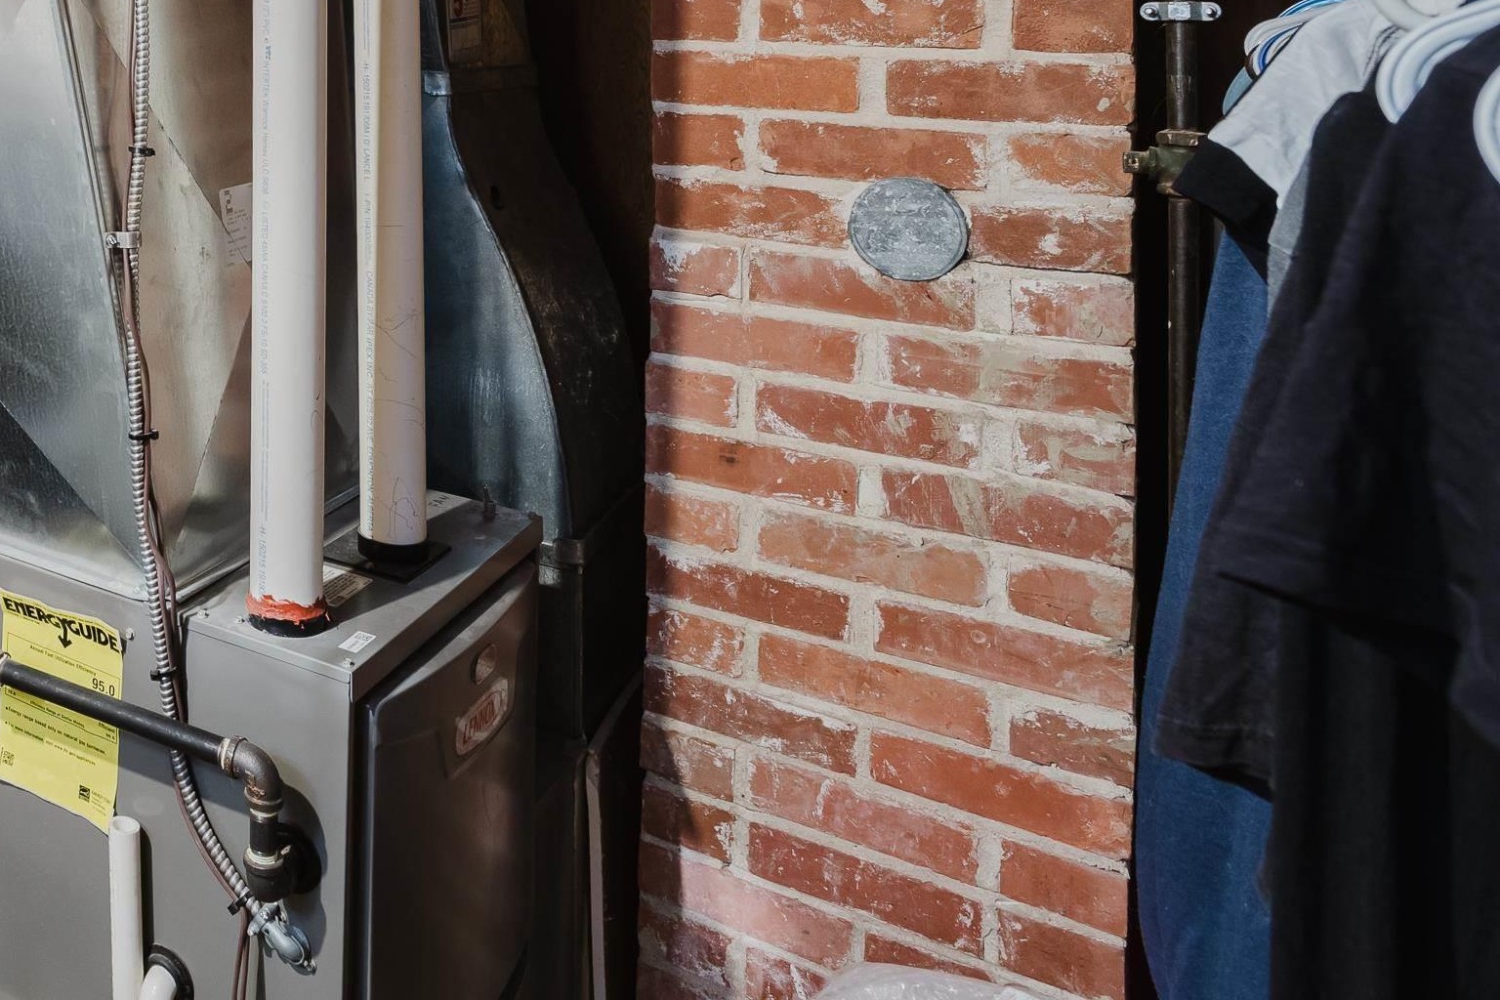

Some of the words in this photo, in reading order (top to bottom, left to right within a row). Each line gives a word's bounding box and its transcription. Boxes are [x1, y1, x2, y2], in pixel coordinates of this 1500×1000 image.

[364, 270, 372, 304] CANADA
[3, 596, 120, 654] ENERGYGUIDE
[92, 678, 115, 697] 95.0
[7, 706, 22, 716] Energy
[21, 713, 34, 722] range
[33, 718, 47, 728] based
[62, 731, 78, 742] natural
